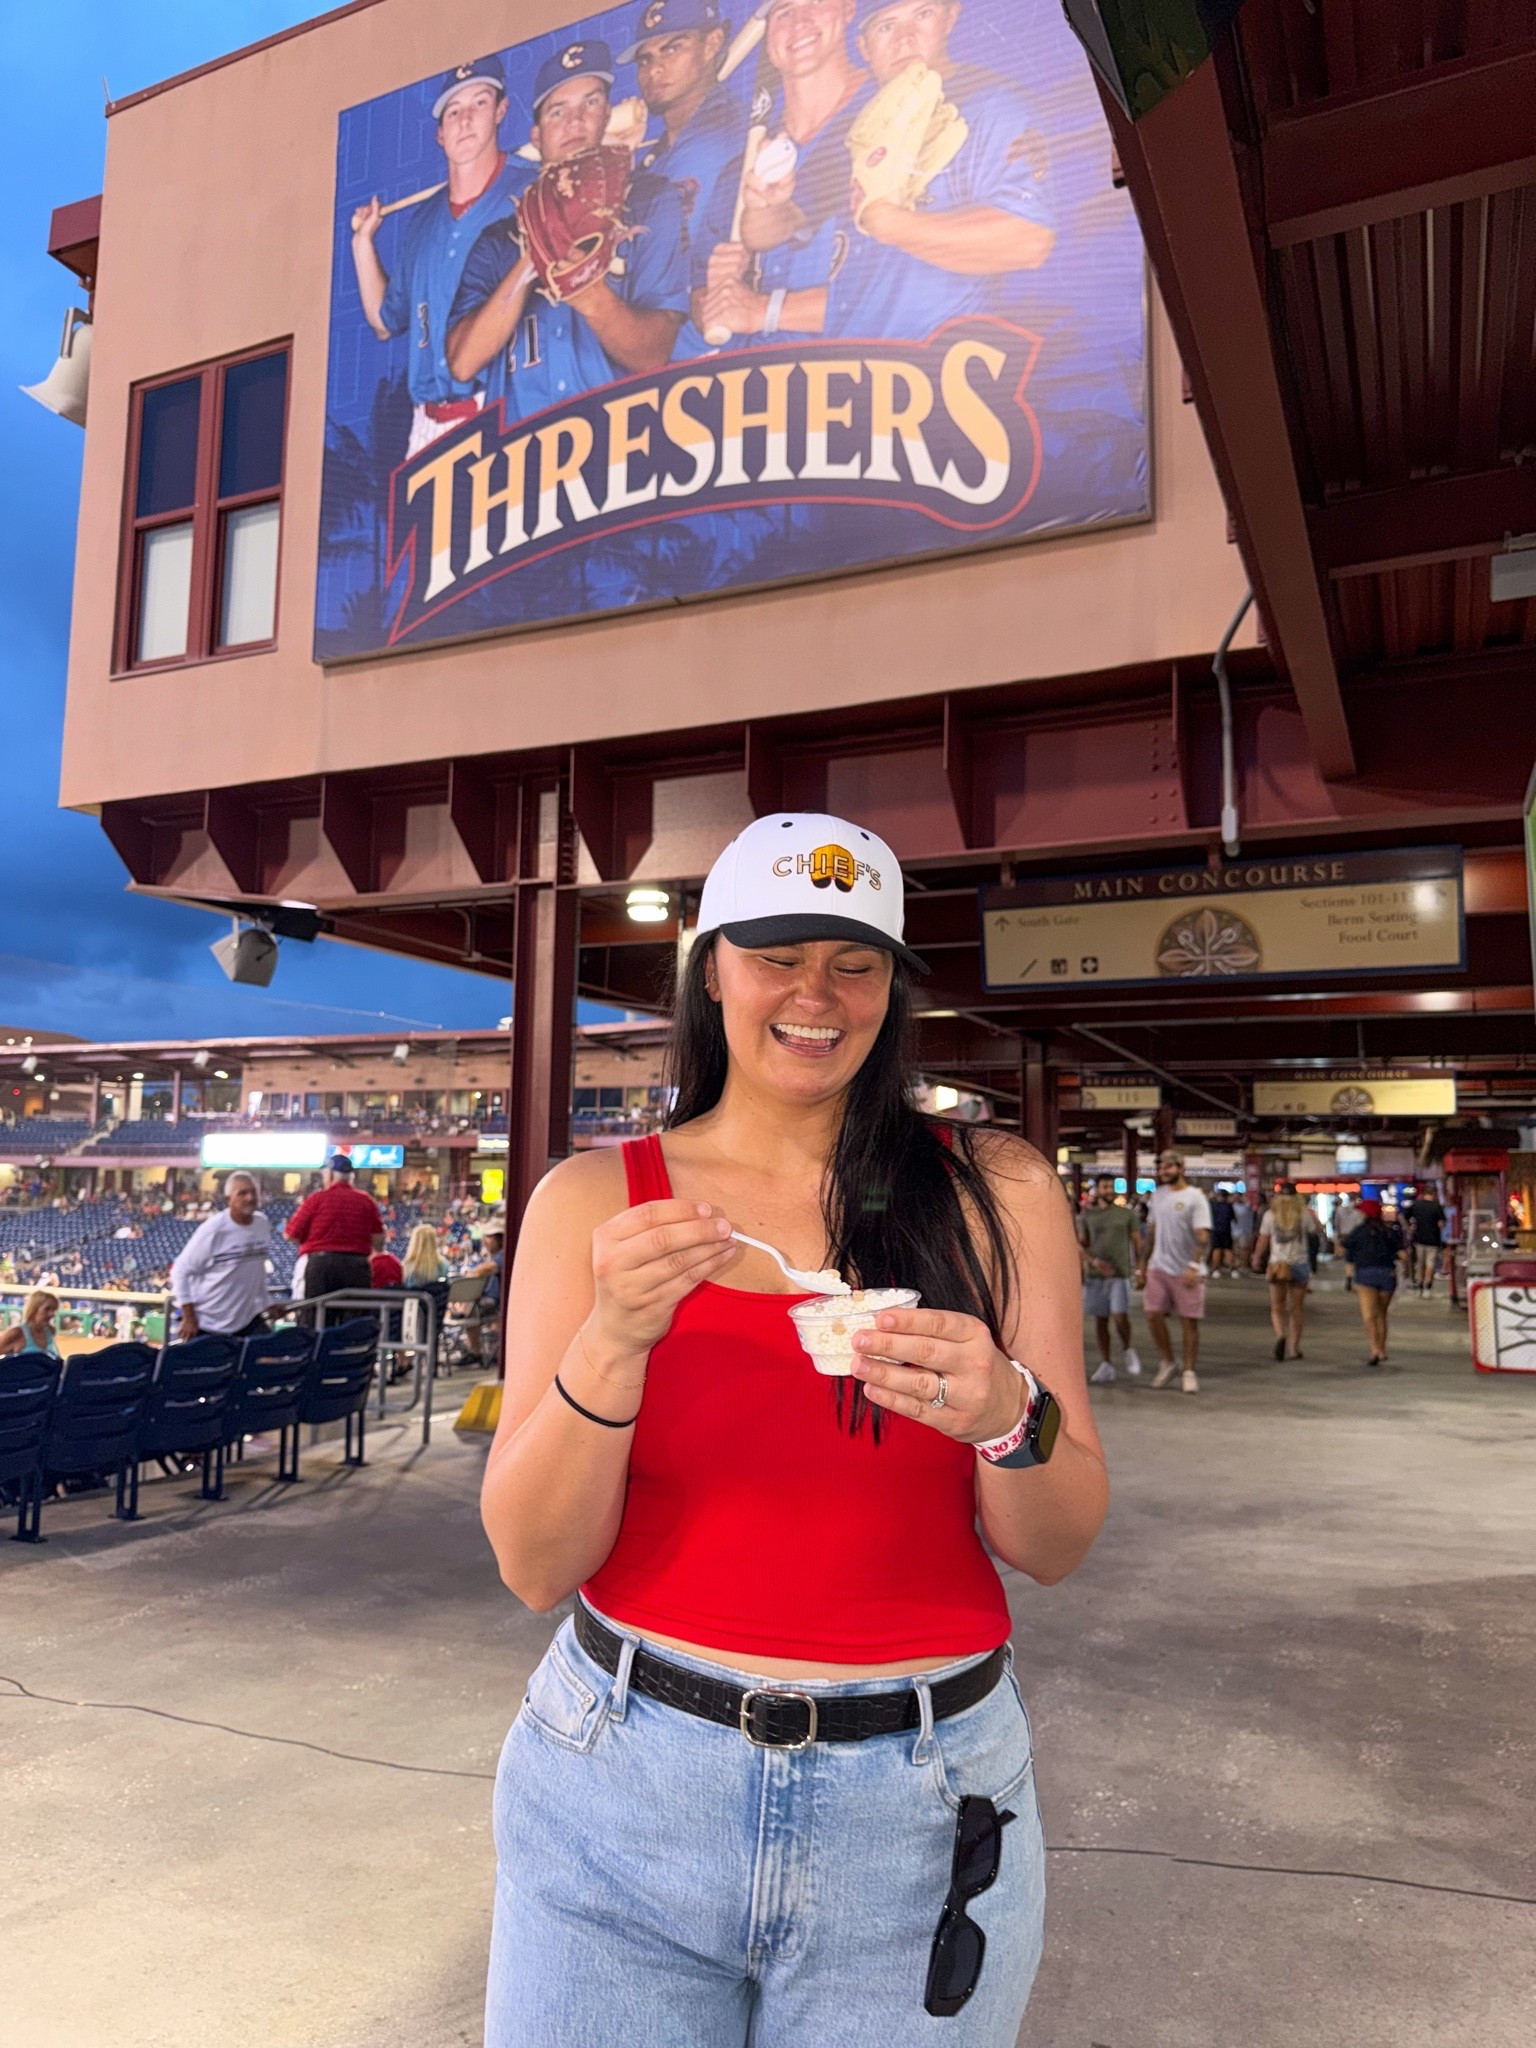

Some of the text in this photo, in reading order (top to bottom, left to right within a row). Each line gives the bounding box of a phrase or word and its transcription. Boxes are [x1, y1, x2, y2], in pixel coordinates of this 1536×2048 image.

[406, 339, 1011, 603] THRESHERS
[772, 853, 882, 891] CHIEF'S
[1074, 861, 1347, 899] MAIN CONCOURSE
[1300, 889, 1416, 910] Sections 101-11
[1327, 910, 1418, 927] Berm Seating
[1338, 928, 1419, 944] Food Court
